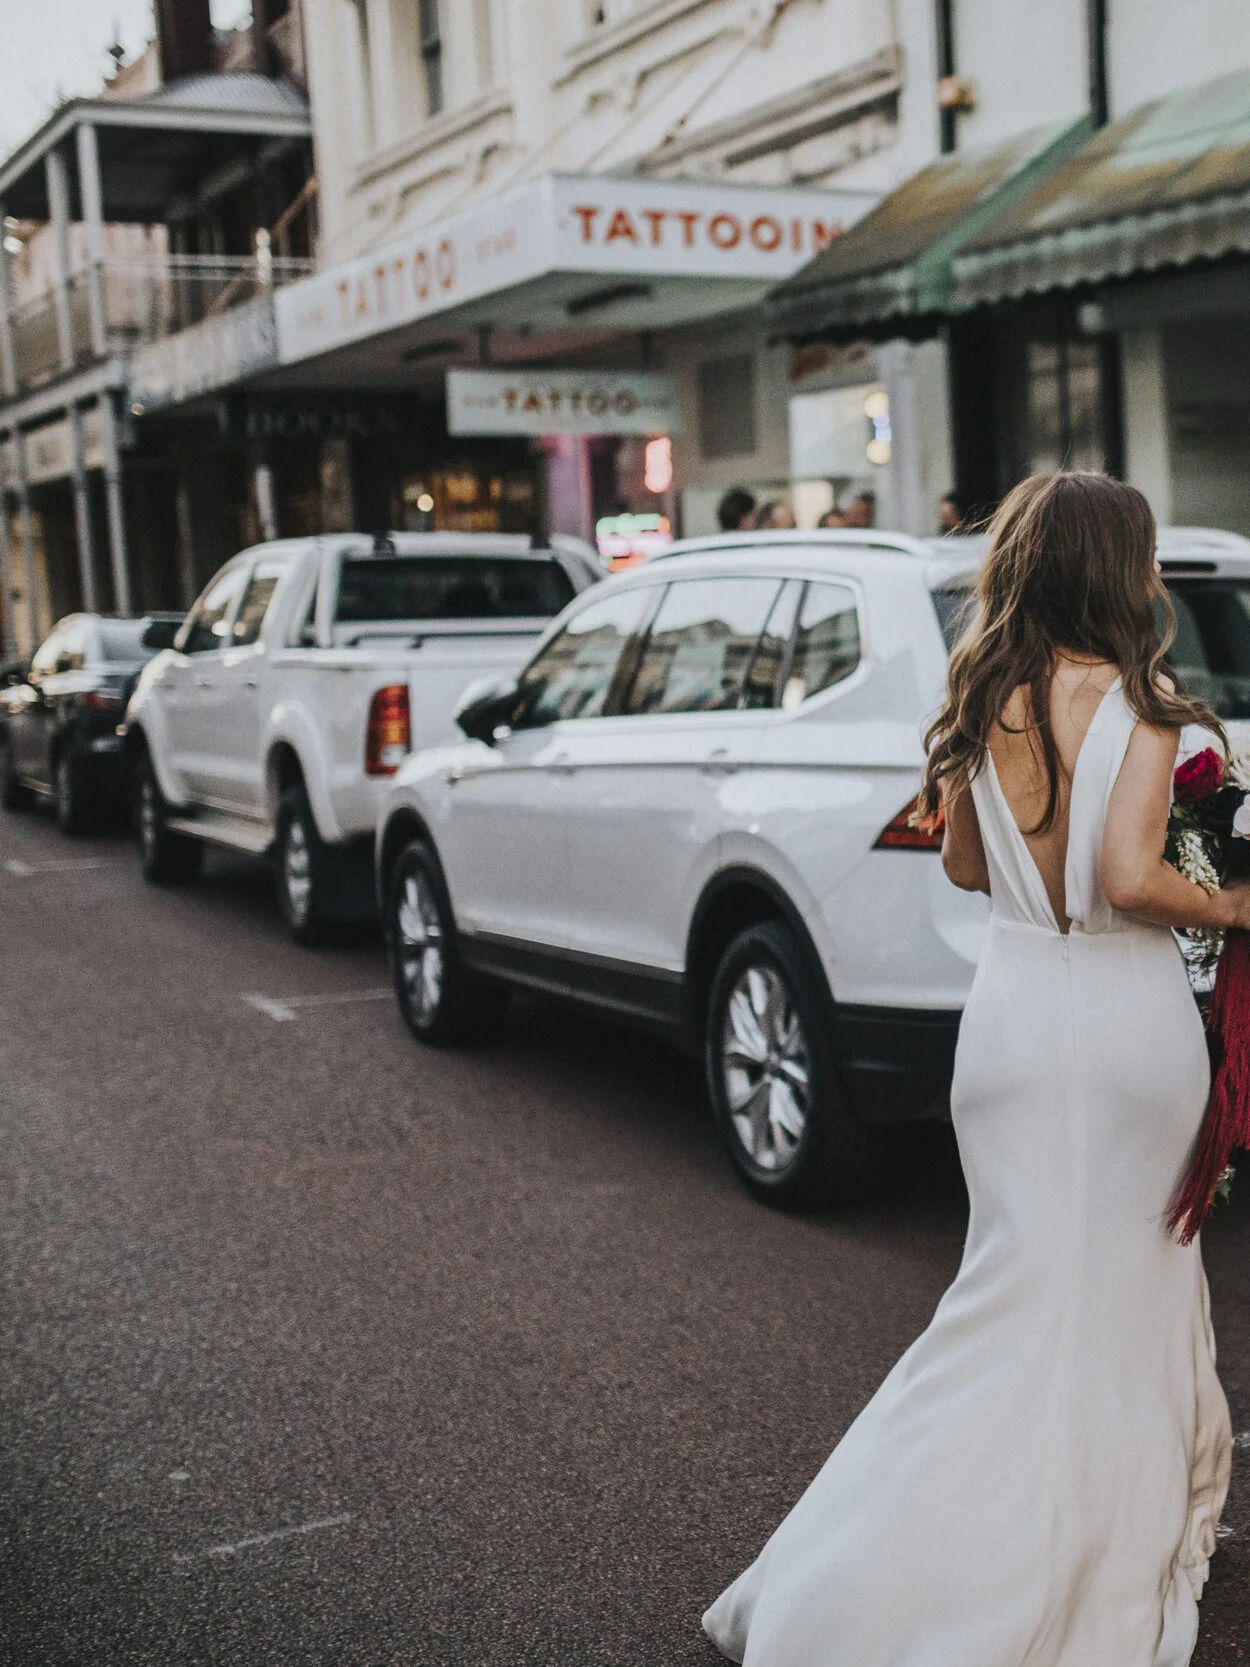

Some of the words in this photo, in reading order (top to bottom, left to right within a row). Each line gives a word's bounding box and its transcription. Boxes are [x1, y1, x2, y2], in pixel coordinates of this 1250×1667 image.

[573, 205, 845, 254] TATTOOIN
[337, 238, 457, 330] TATTOO
[504, 387, 638, 417] TATTOO
